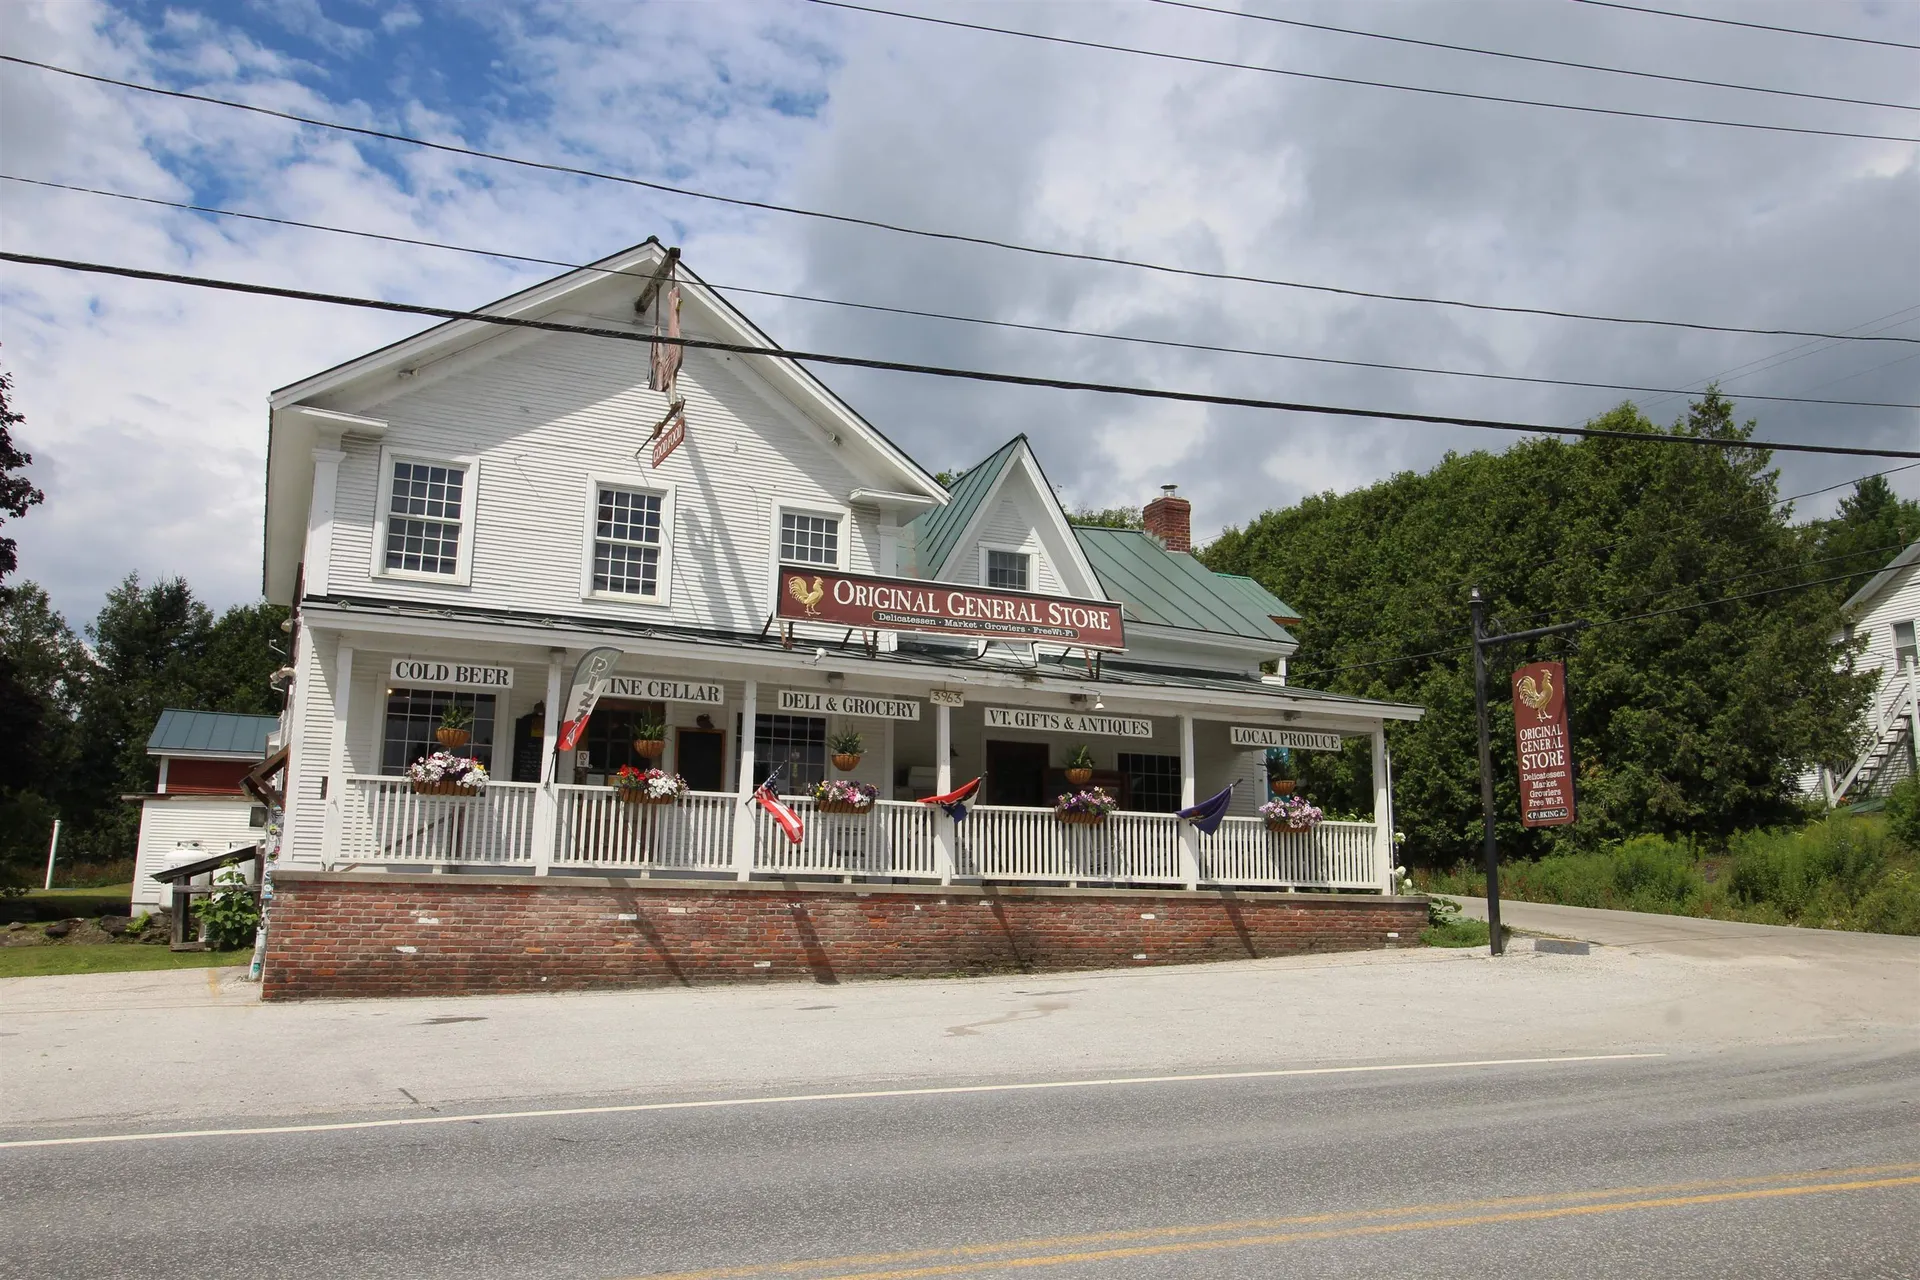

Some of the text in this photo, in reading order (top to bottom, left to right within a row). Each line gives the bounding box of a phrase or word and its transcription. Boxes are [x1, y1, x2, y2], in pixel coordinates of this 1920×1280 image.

[653, 424, 682, 463] GOOD FOOD
[833, 579, 1111, 630] ORIGINAL GENERAL STORE
[878, 613, 936, 625] Delicatessen
[944, 619, 977, 629] Market
[984, 622, 1026, 632] Growlers
[395, 661, 510, 686] COLD BEER
[647, 680, 720, 702] CELLAR
[933, 691, 962, 704] 3963
[566, 656, 608, 747] PIZZA
[781, 691, 916, 718] DELI & GROCERY
[989, 709, 1150, 737] VT. GIFTS & ANTIQUES
[1520, 724, 1563, 741] ORIGINAL
[1234, 728, 1339, 749] LOCAL PRODUCE
[1521, 737, 1564, 753] GENERAL
[1522, 750, 1565, 770] STORE
[1523, 770, 1566, 781] Delicatessen
[1532, 780, 1557, 789] Market
[1528, 796, 1564, 807] Free Wi-Fi
[1529, 788, 1561, 798] Growlers
[1532, 810, 1559, 819] PARKING
